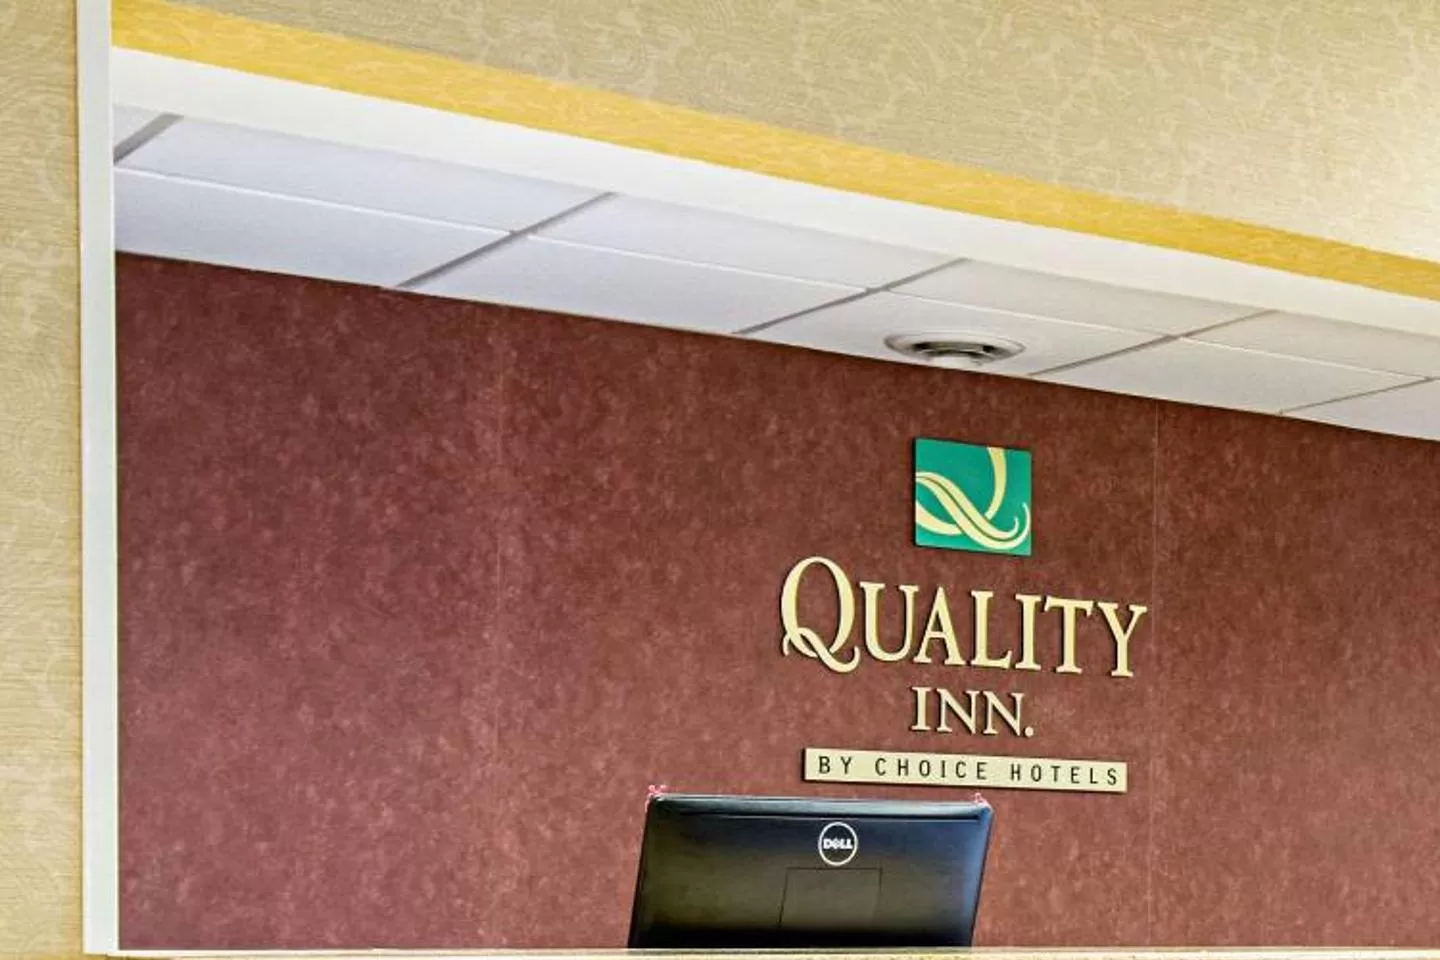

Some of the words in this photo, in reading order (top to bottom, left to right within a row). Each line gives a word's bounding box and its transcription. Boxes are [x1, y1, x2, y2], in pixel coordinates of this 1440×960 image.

[780, 555, 1148, 678] QUALITY
[818, 755, 854, 775] BY
[874, 757, 988, 781] CHOICE
[1010, 763, 1118, 786] HOTELS
[823, 838, 854, 850] DELL
